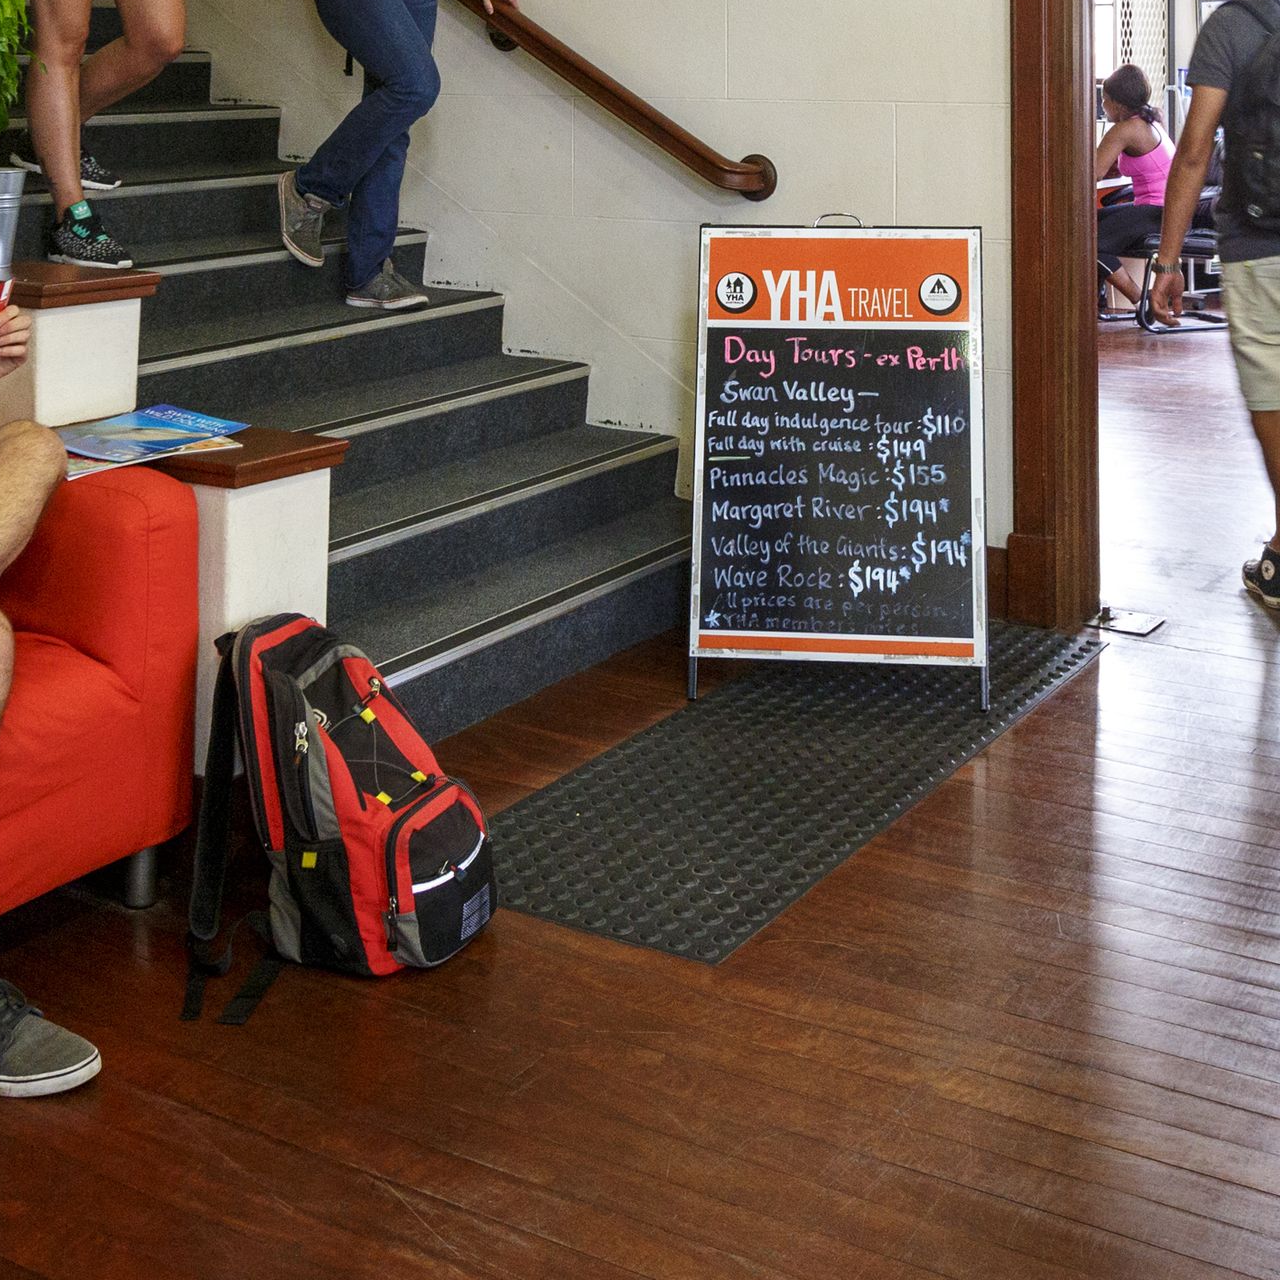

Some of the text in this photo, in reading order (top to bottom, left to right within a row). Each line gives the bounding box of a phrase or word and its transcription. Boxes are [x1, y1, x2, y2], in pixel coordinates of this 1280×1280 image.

[762, 270, 914, 322] YHA TRAVEL
[724, 335, 776, 378] Day
[785, 337, 856, 368] Tours
[875, 353, 900, 367] ex
[906, 345, 965, 371] Perth
[720, 381, 778, 404] Swan
[708, 411, 737, 428] Full
[742, 411, 769, 436] day
[774, 412, 871, 436] indulgence
[708, 436, 734, 453] Full
[738, 437, 764, 457] day
[770, 436, 806, 453] with
[709, 465, 808, 489] Pinnacles
[712, 497, 805, 529] Margaret
[711, 534, 770, 564] Valley
[774, 532, 793, 554] of
[797, 534, 829, 555] the
[713, 565, 767, 589] Wave
[741, 593, 796, 612] prices
[804, 597, 833, 611] are
